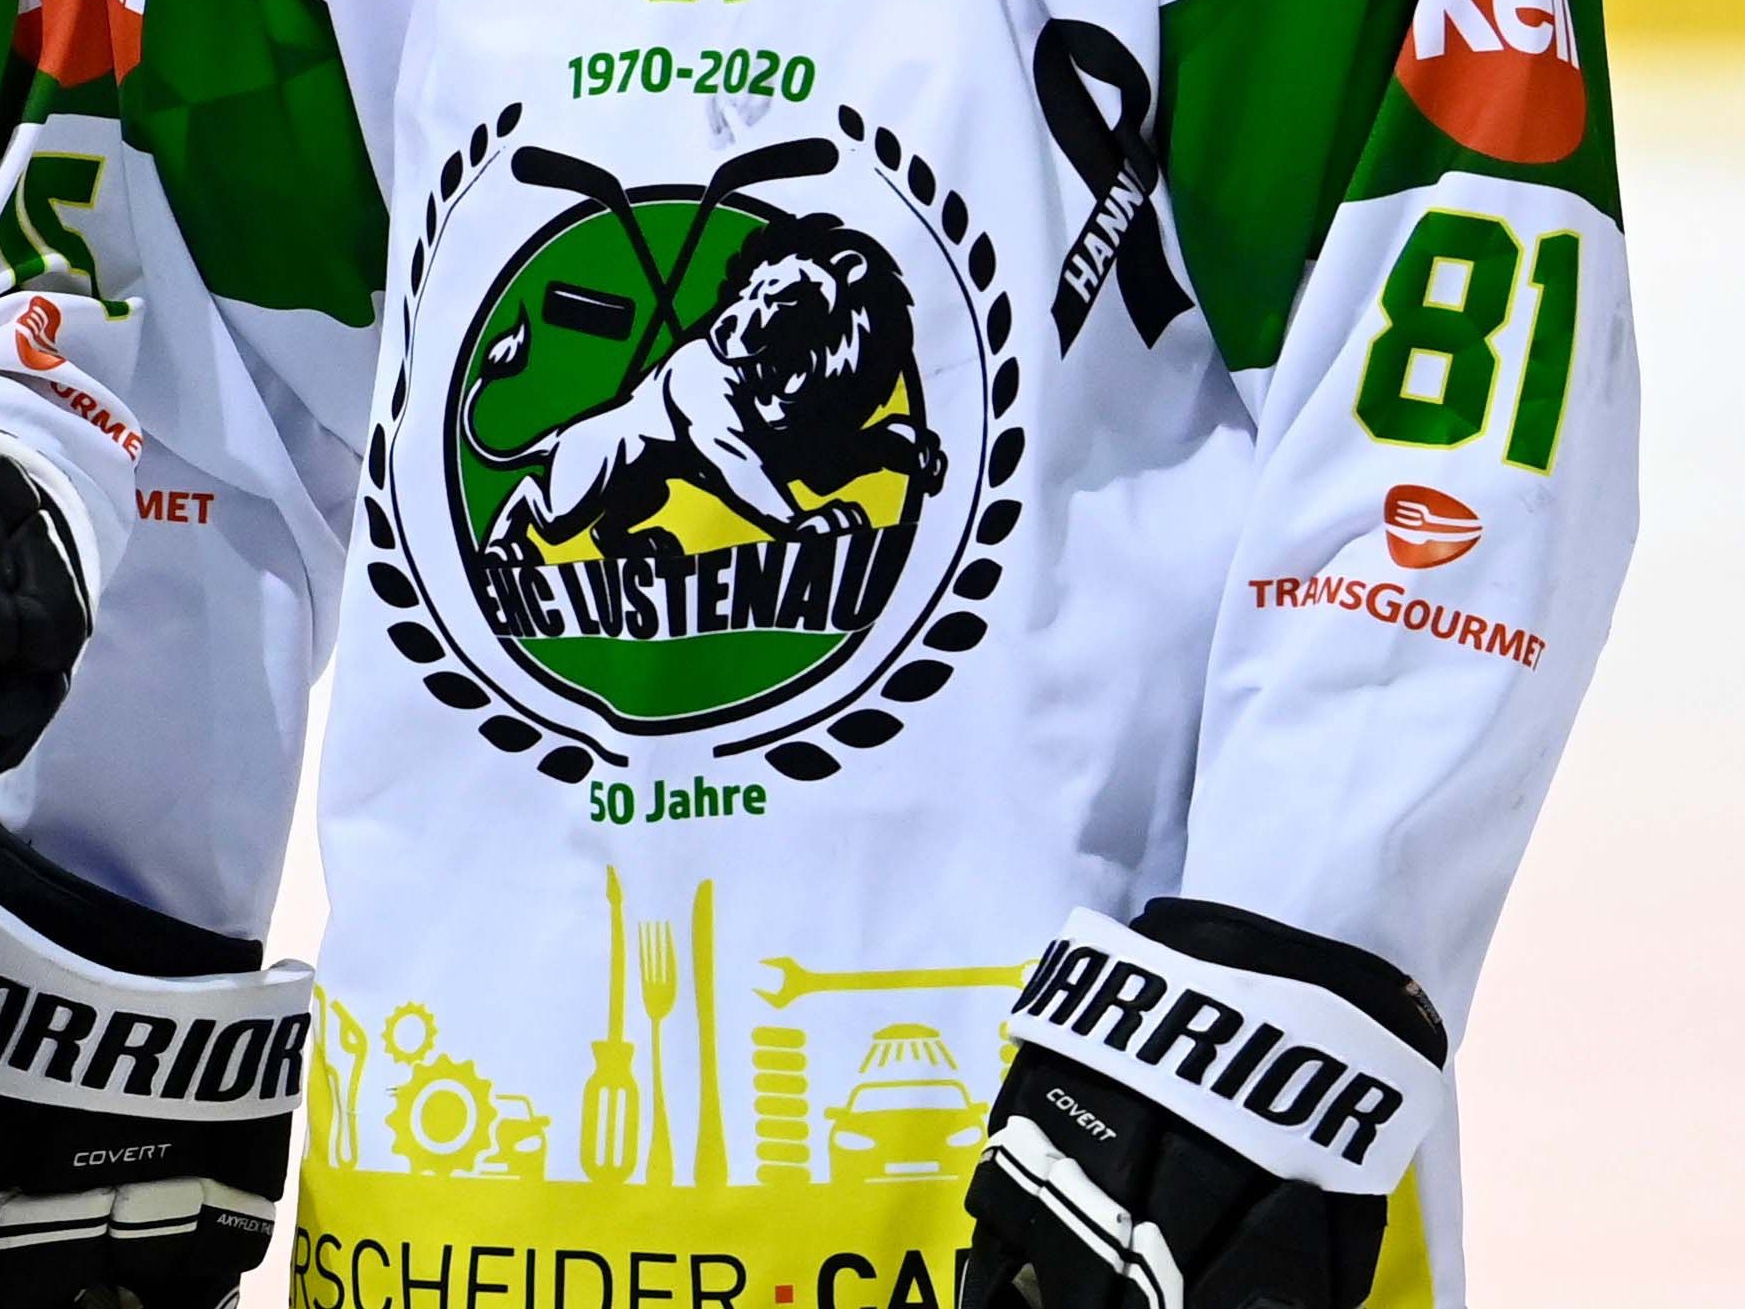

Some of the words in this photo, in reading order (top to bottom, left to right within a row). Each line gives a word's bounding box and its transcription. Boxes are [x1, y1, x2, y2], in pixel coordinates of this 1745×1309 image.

[567, 45, 817, 104] 1970-2020
[1353, 205, 1584, 478] 81
[482, 563, 567, 639] EHC
[558, 521, 917, 641] LUSTENAU
[589, 780, 635, 826] 50
[645, 775, 767, 824] Jahre
[1045, 1087, 1117, 1142] COVERT
[72, 1143, 173, 1168] COVERT
[816, 1248, 970, 1309] CA
